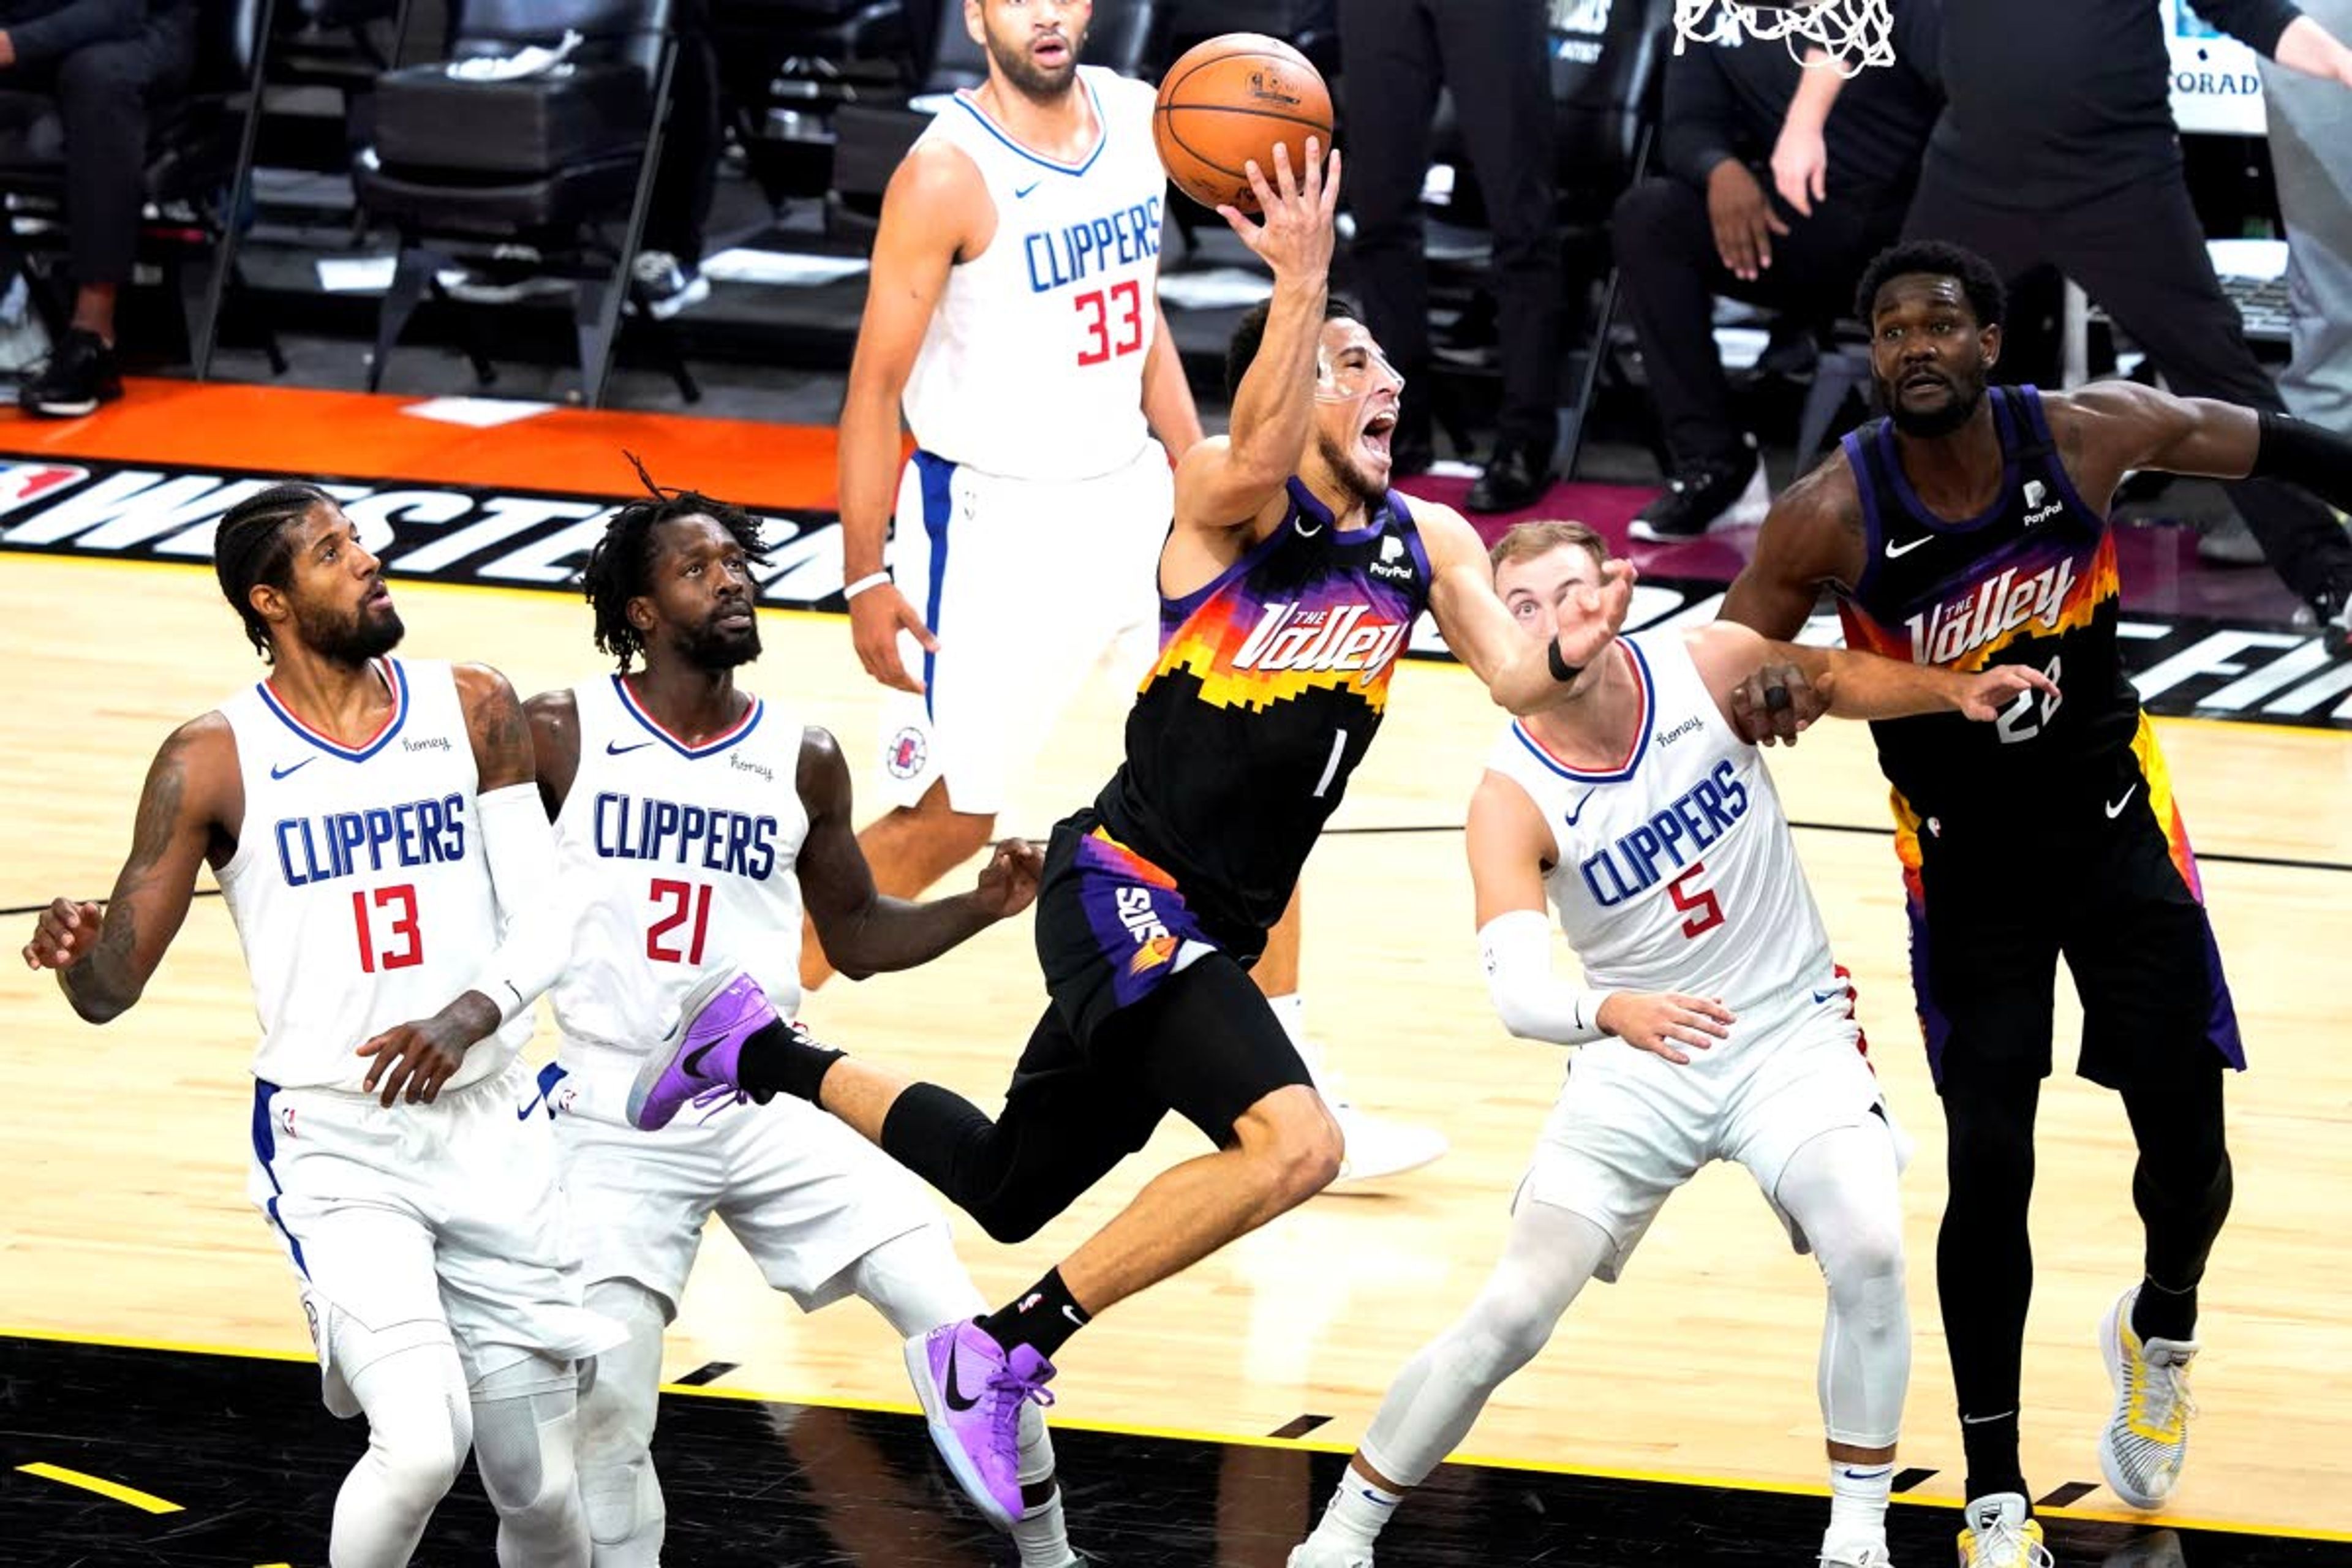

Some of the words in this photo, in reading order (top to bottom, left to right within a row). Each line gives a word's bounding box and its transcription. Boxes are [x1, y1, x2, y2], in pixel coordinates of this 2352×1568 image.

[1074, 279, 1142, 366] 33
[0, 470, 894, 601] WSTEN
[2023, 499, 2063, 527] PayPal
[1370, 562, 1412, 580] PayPal
[1904, 556, 2076, 665] Valley
[1946, 593, 1973, 621] THE
[1231, 601, 1409, 688] Valley
[1294, 611, 1327, 624] THE
[402, 737, 452, 752] honey
[731, 753, 774, 782] honey
[1313, 729, 1348, 796] 1
[1656, 716, 1704, 747] honey
[274, 792, 465, 886] CLIPPERS
[594, 791, 777, 881] CLIPPERS
[1580, 759, 1748, 907] CLIPPERS
[353, 883, 423, 973] 13
[646, 877, 712, 965] 21
[1667, 861, 1725, 939] 5
